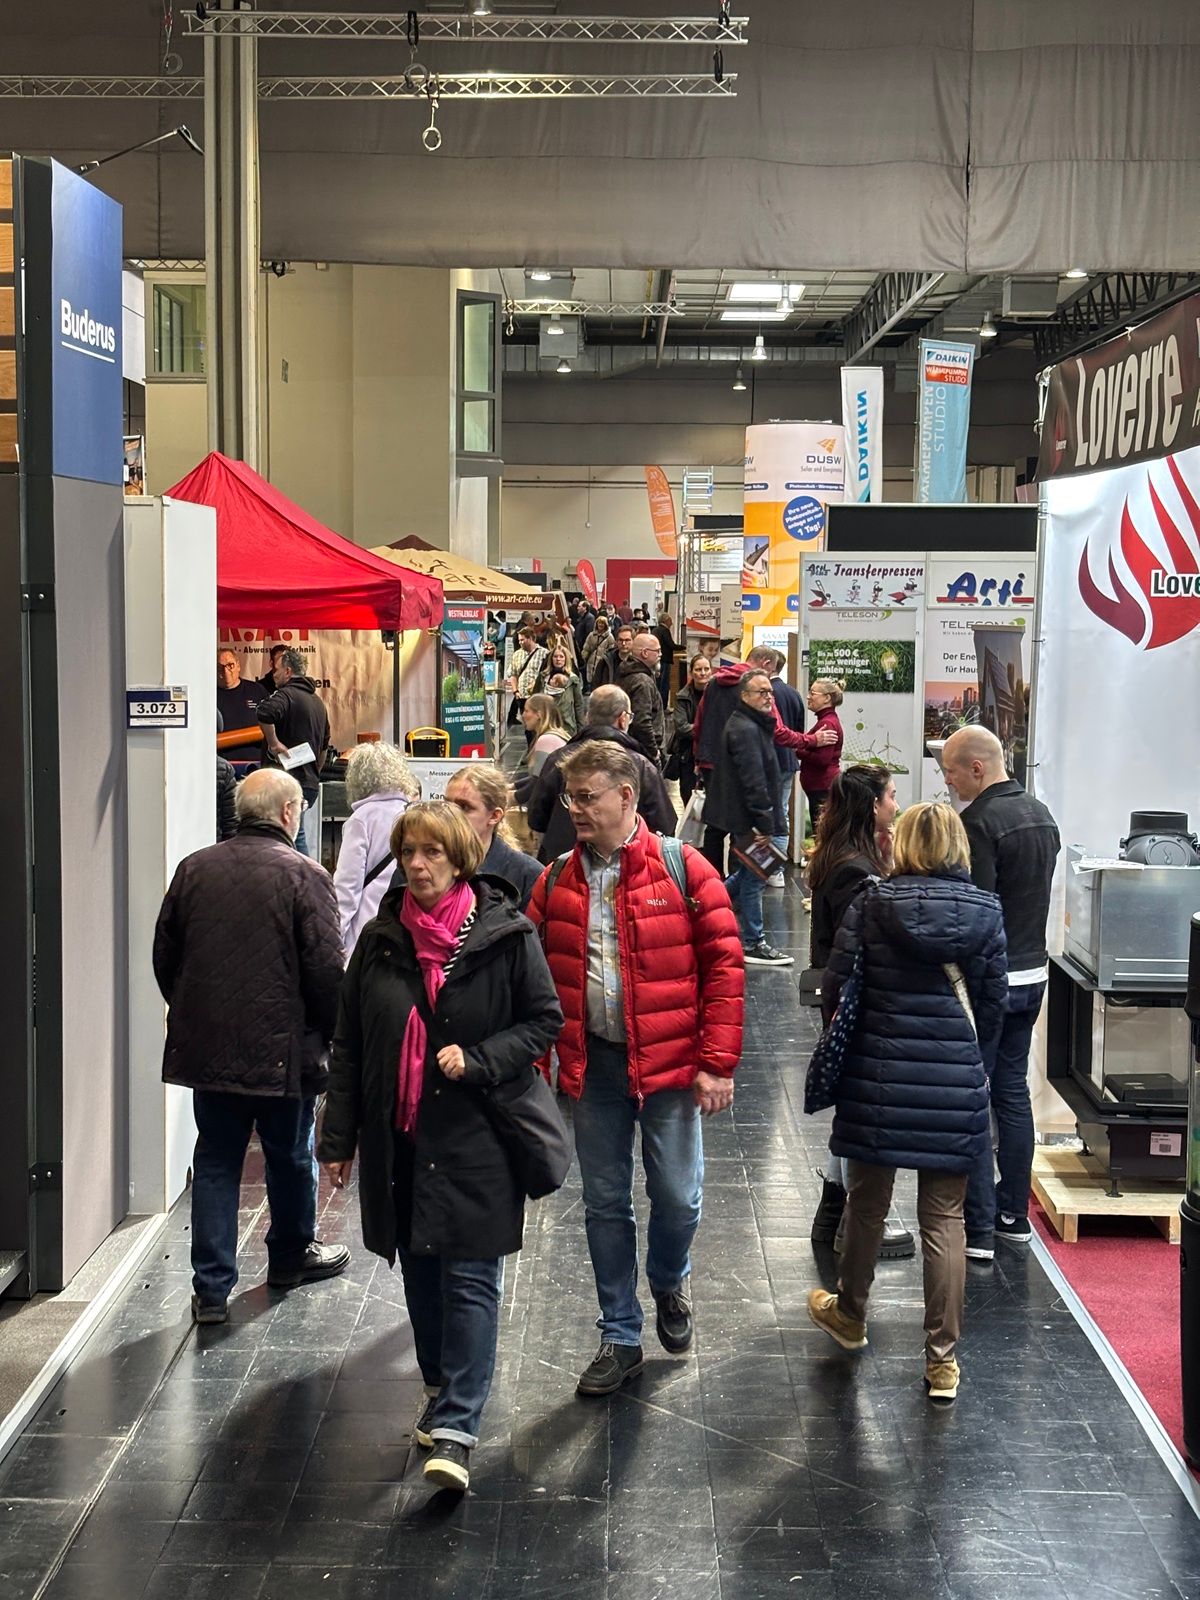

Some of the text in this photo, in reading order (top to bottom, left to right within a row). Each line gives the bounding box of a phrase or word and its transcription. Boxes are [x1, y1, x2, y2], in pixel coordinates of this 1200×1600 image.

[61, 298, 116, 352] Buderus
[936, 353, 968, 364] DAIKIN
[926, 366, 968, 377] WÄRMEPUMPN
[944, 374, 967, 384] STUDO
[1074, 334, 1183, 467] Loverre
[935, 386, 947, 452] STUDIO
[856, 390, 869, 481] DAIKIN
[806, 455, 842, 464] DUSW
[797, 521, 820, 536] 1 Tag!
[834, 564, 924, 579] Transferpressen
[243, 646, 271, 654] Abwas
[834, 648, 850, 657] 500
[852, 648, 859, 657] €
[943, 652, 958, 660] Der
[837, 657, 869, 667] weniger
[945, 665, 958, 673] für
[137, 703, 176, 713] 3.073
